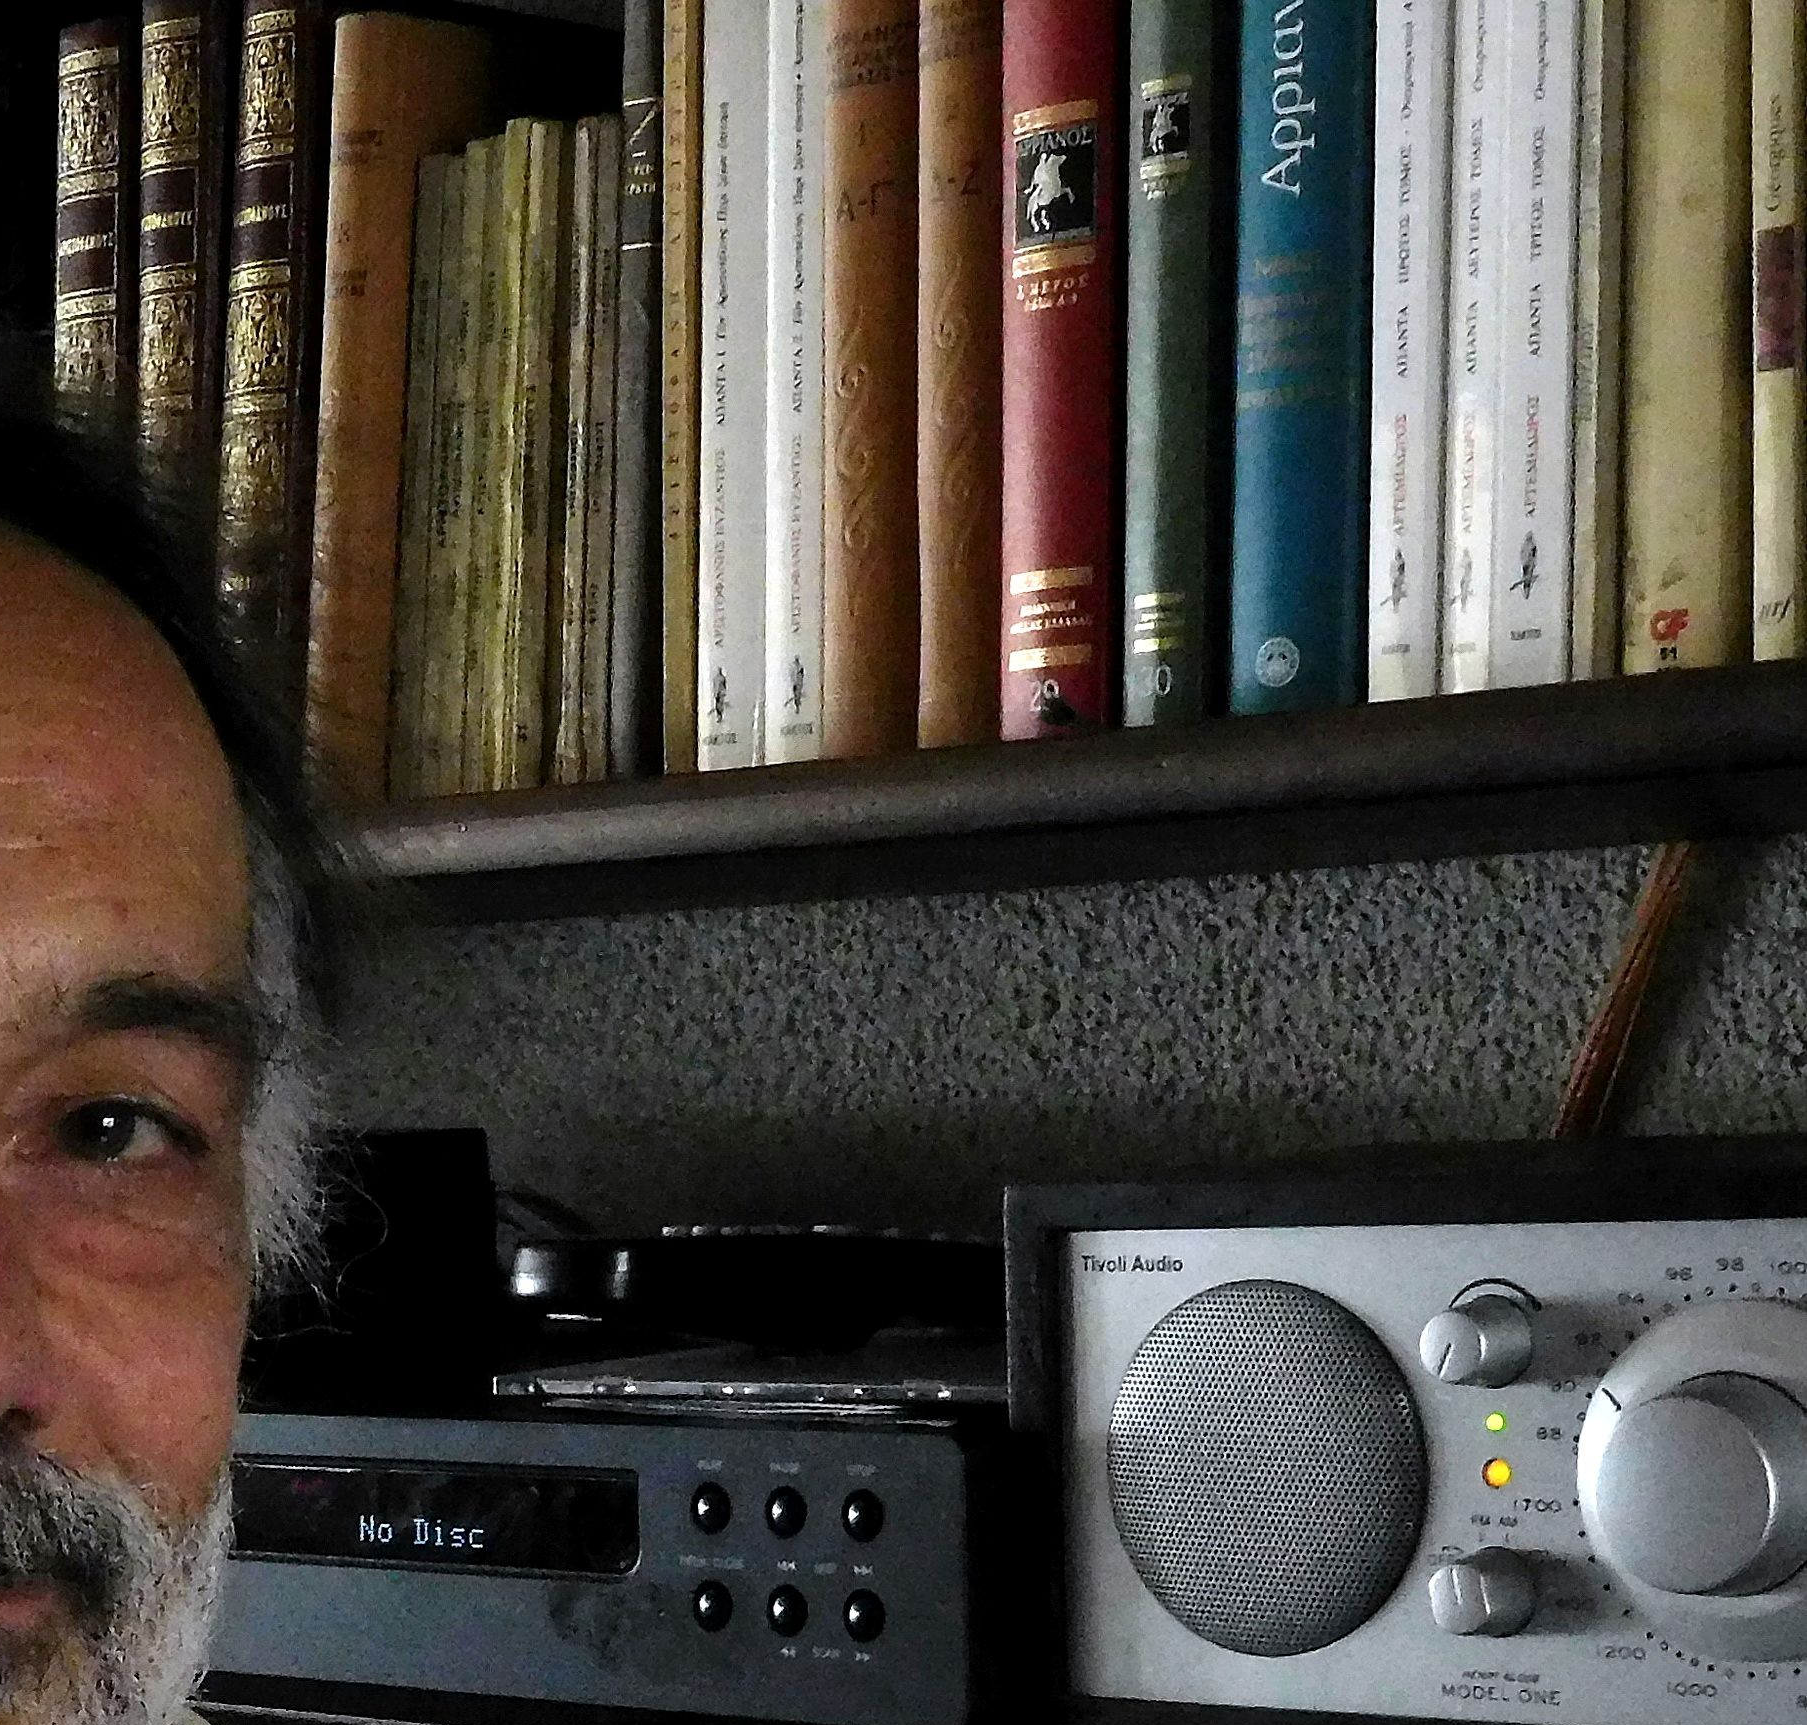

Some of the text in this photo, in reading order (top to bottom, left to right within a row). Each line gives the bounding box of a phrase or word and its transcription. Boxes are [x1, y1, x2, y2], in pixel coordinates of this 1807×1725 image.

[1398, 144, 1412, 207] ΤΟΜΟΣ
[1469, 117, 1483, 182] ΤΟΜΟΣ
[1529, 126, 1546, 191] ΤΟΜΟΣ
[1397, 304, 1410, 380] ΑΠΑΝΤΑ
[1465, 300, 1479, 376] ΑΠΑΝΤΑ
[1528, 283, 1543, 358] ΑΠΑΝΤΑ
[1081, 1254, 1183, 1272] Tivoli Audio
[1715, 1257, 1744, 1272] 98
[358, 1514, 485, 1549] No Disc
[1513, 1497, 1562, 1514] 1700
[1440, 1682, 1562, 1707] MODEL ONE
